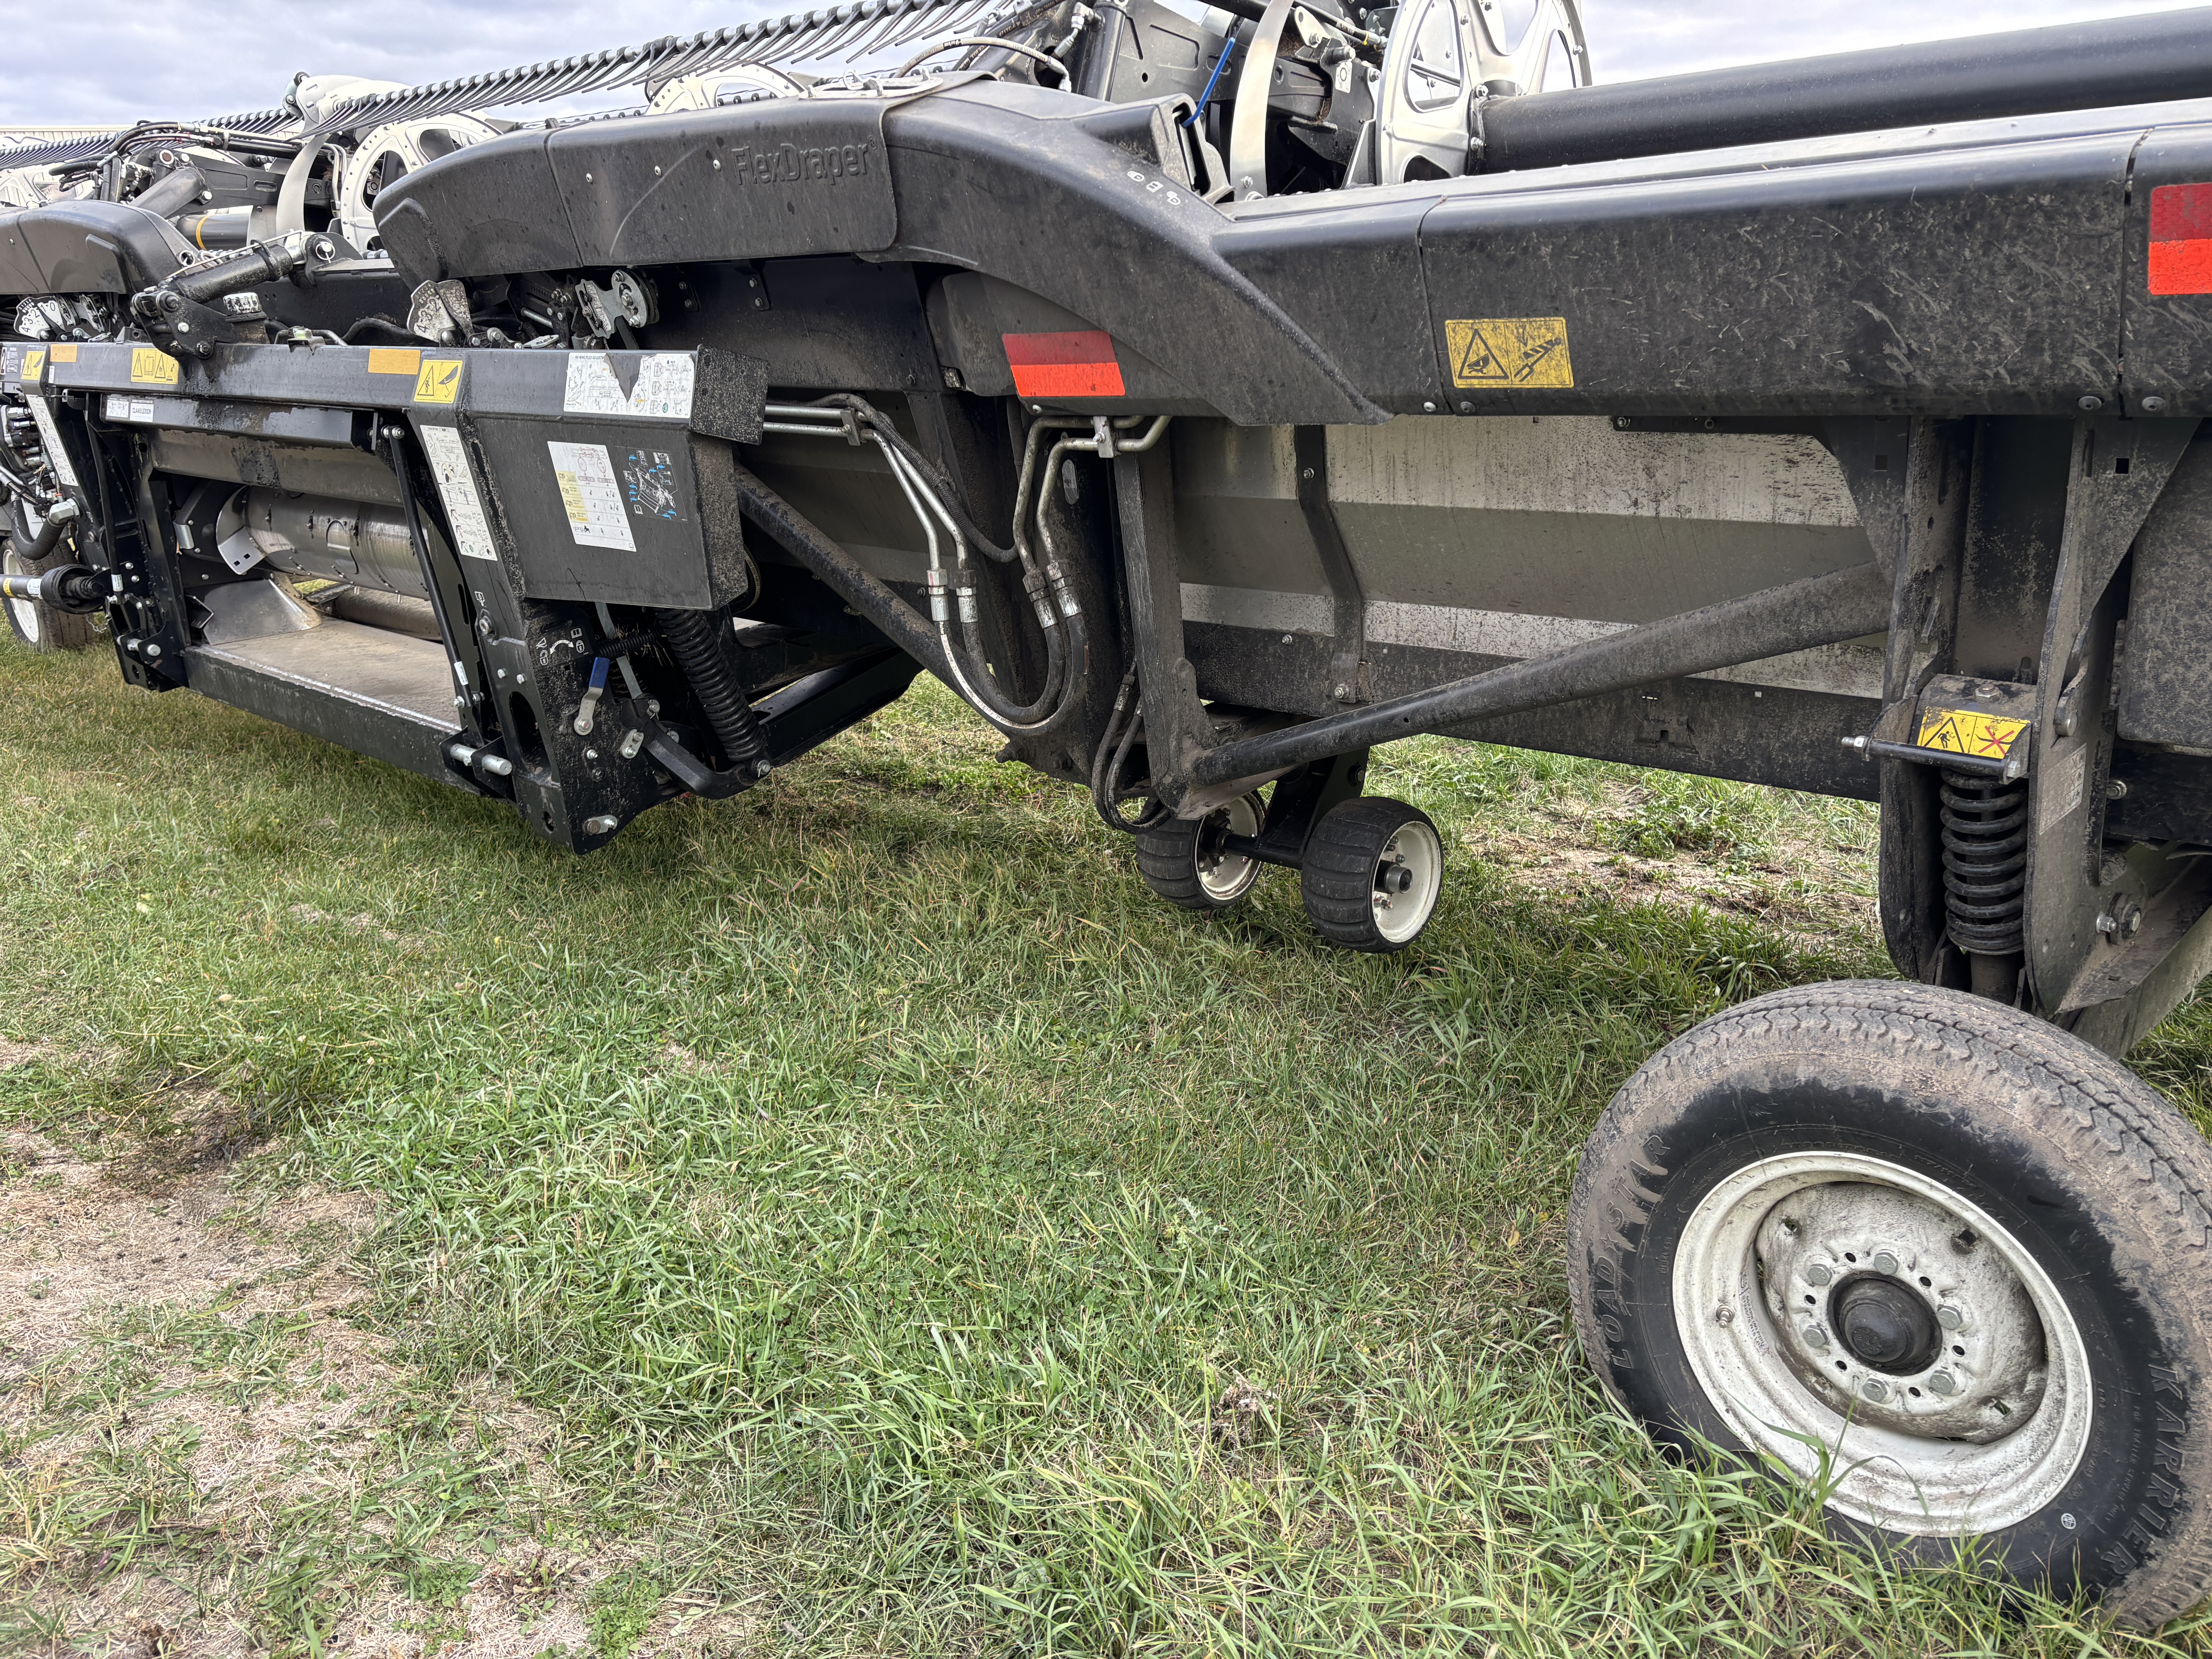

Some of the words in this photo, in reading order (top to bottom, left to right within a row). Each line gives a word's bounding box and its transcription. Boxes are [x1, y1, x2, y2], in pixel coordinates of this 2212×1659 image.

[31, 309, 40, 318] 2
[40, 304, 46, 313] 1
[50, 302, 55, 311] 0
[429, 299, 441, 312] 2
[421, 310, 433, 321] 3
[417, 324, 429, 333] 4
[1605, 1135, 1671, 1231] STAR
[1596, 1256, 1634, 1369] LOAD
[2100, 1364, 2186, 1575] KARRIER
